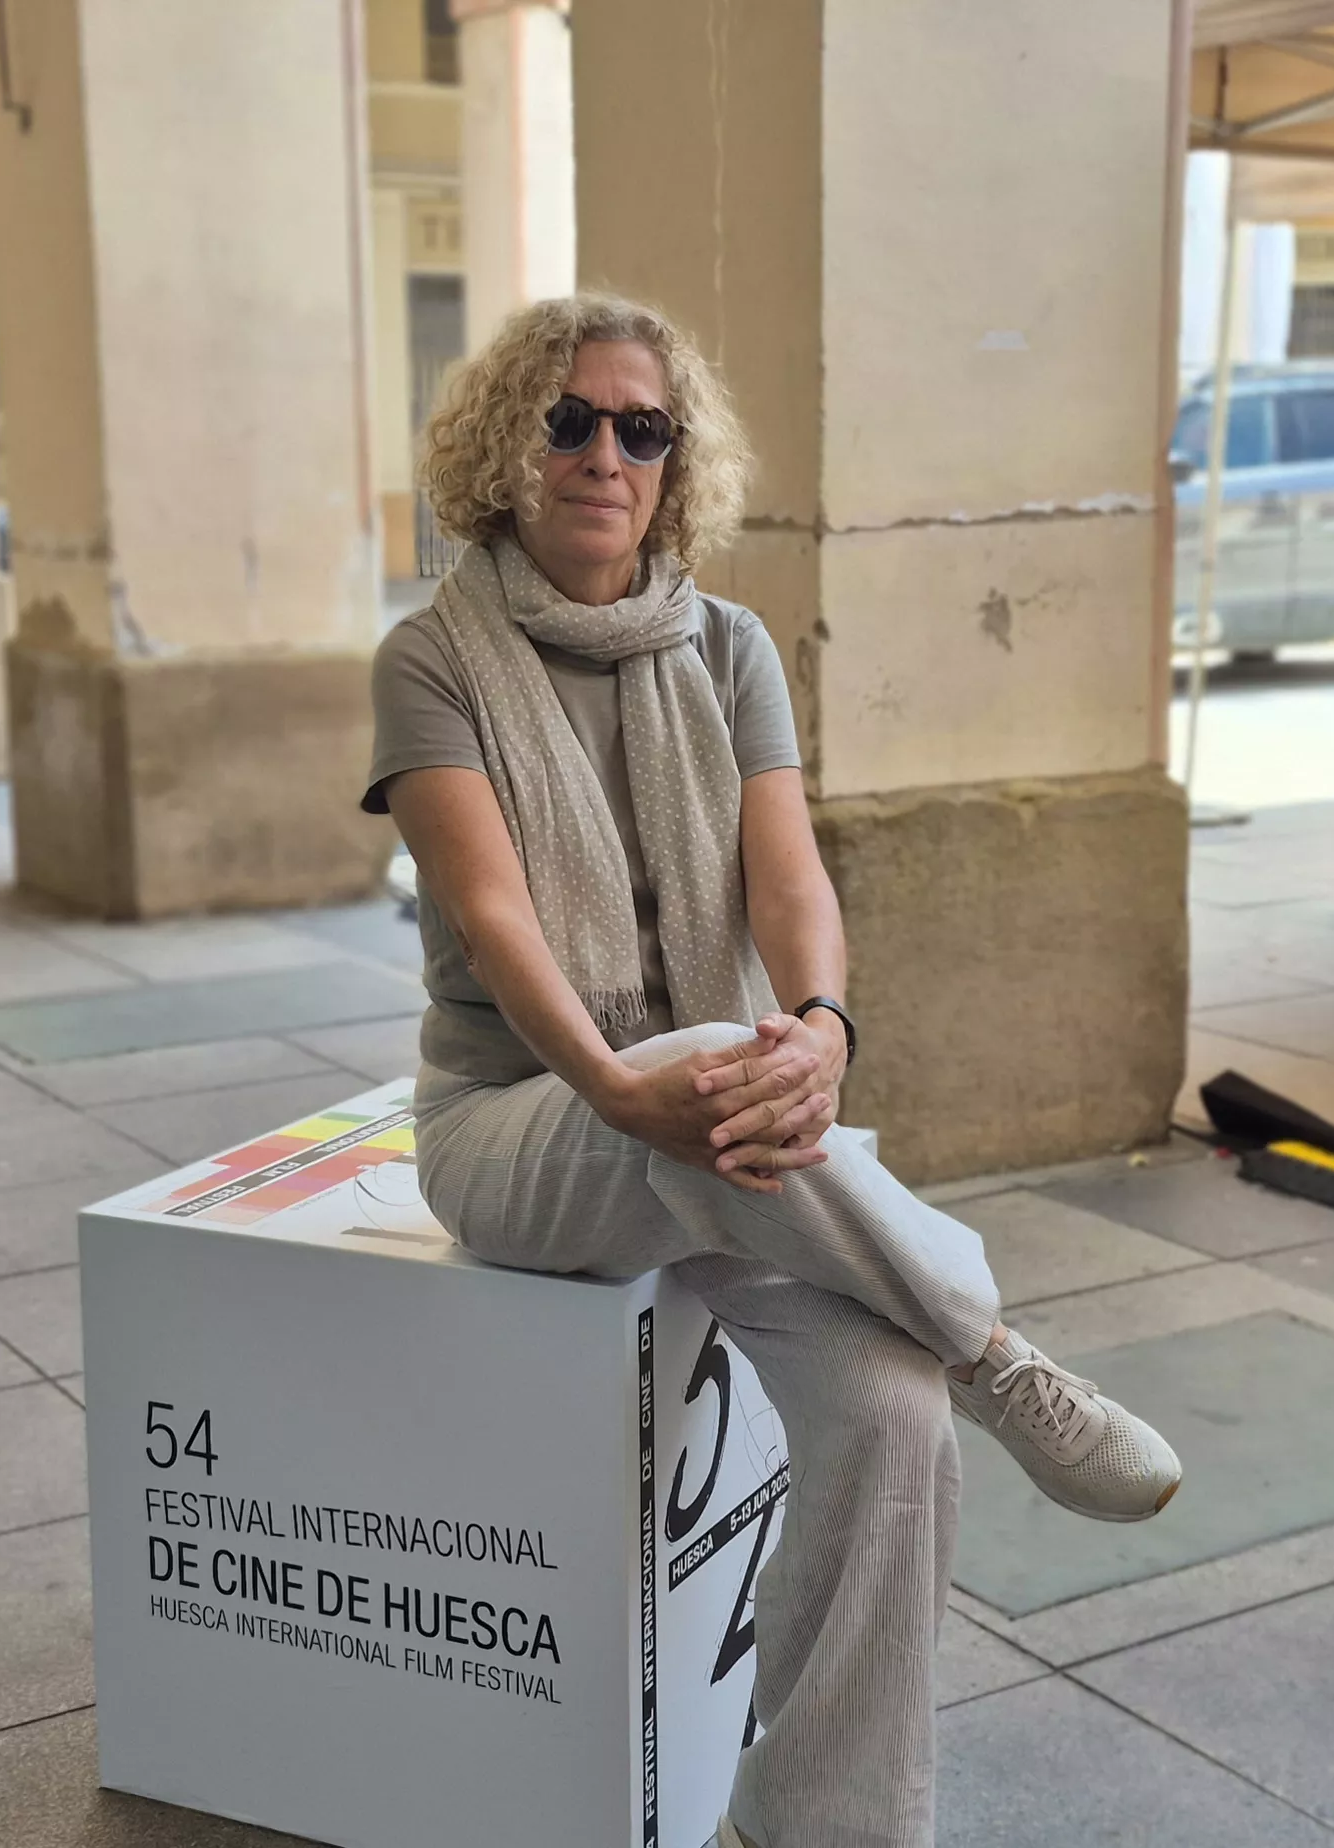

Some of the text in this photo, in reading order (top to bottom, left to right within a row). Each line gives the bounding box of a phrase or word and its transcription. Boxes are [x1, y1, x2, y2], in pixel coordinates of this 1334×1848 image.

[172, 1185, 247, 1214] FESTIVAL
[261, 1161, 301, 1177] FILM
[641, 1316, 652, 1353] DE
[145, 1401, 218, 1476] 54
[641, 1370, 652, 1429] CINE
[642, 1446, 652, 1483] DE
[145, 1488, 558, 1570] FESTIVAL INTERNACIONAL
[672, 1533, 714, 1582] HUESCA
[730, 1501, 752, 1532] 5-13
[752, 1486, 770, 1513] JUN
[148, 1535, 561, 1665] DE CINE DE HUESCA
[642, 1499, 655, 1693] INTERNACIONAL
[150, 1593, 563, 1705] HUESCA INTERNATIONAL FILM FESTIVAL
[645, 1707, 655, 1821] FESTIVAL
